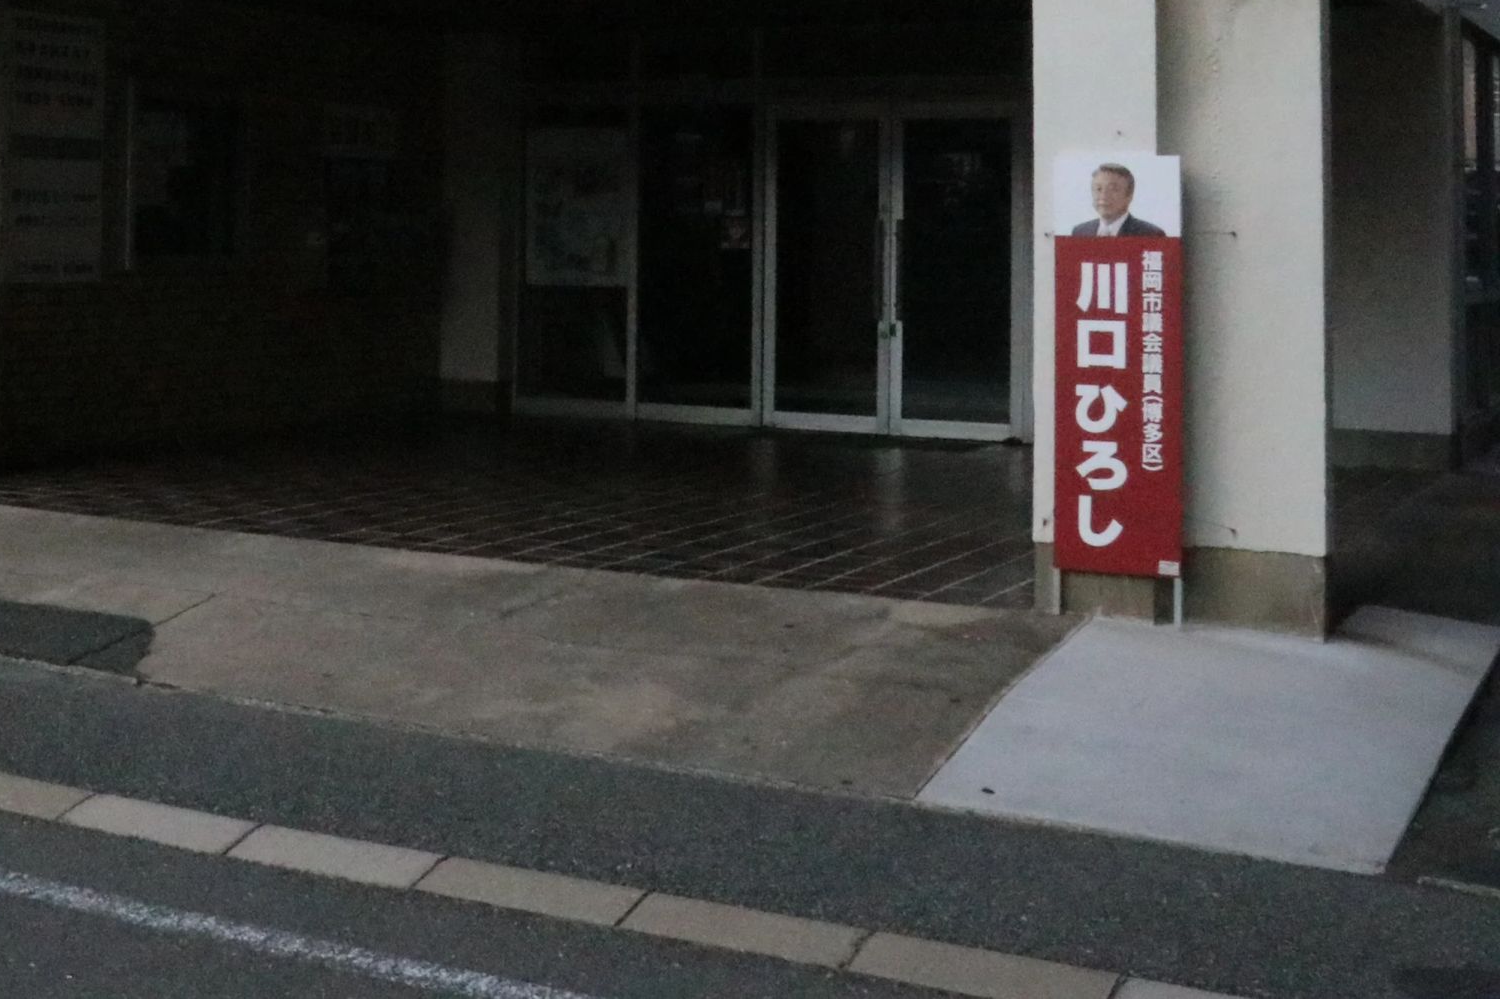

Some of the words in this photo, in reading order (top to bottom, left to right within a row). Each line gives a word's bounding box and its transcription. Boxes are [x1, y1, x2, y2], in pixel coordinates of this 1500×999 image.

[1075, 261, 1129, 547] 川口ひろし
[1141, 250, 1164, 471] 福岡市議会議員(博多区)
